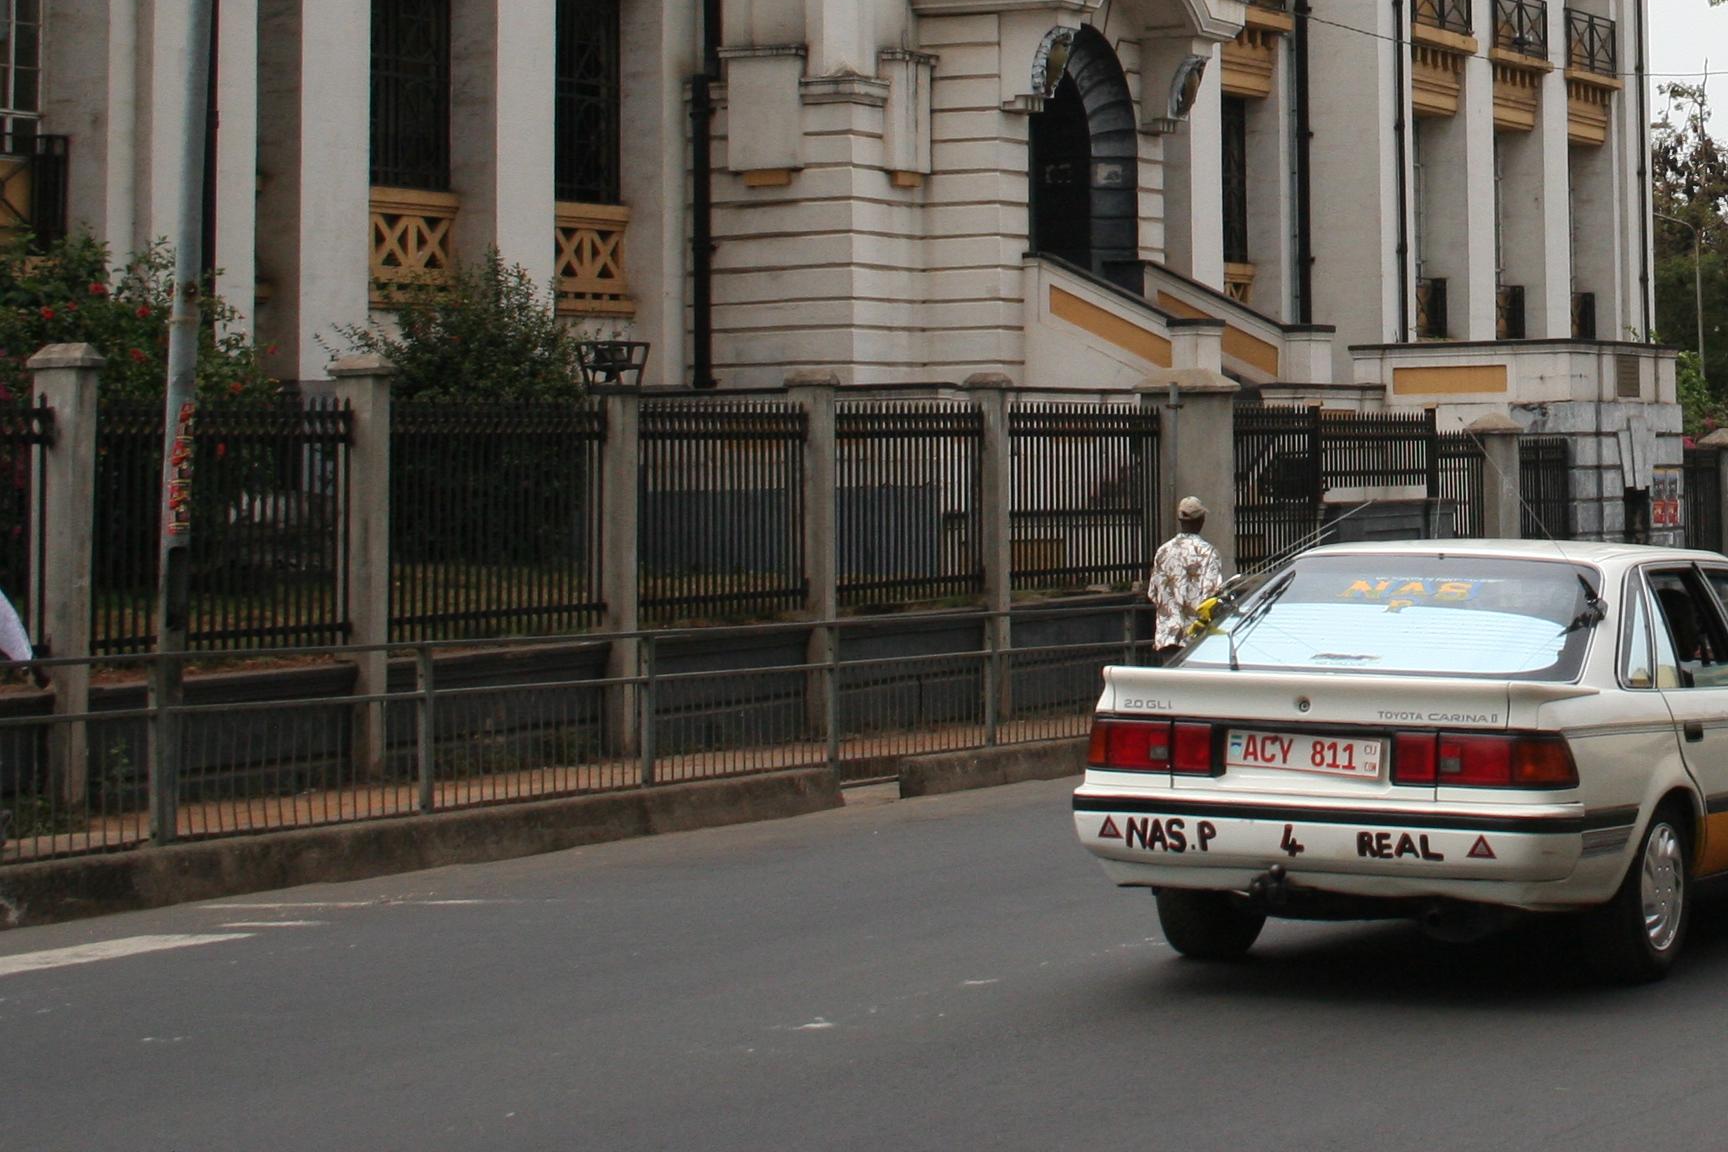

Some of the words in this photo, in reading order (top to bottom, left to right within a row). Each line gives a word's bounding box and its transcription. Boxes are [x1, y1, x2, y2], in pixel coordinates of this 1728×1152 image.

[1337, 578, 1482, 600] NAS
[1378, 710, 1423, 722] TOYOTA
[1427, 713, 1489, 724] CARINA
[1242, 734, 1294, 765] ACY
[1310, 740, 1357, 771] 811
[1125, 816, 1217, 853] NAS.P
[1280, 823, 1305, 858] 4
[1356, 830, 1444, 862] REAL
